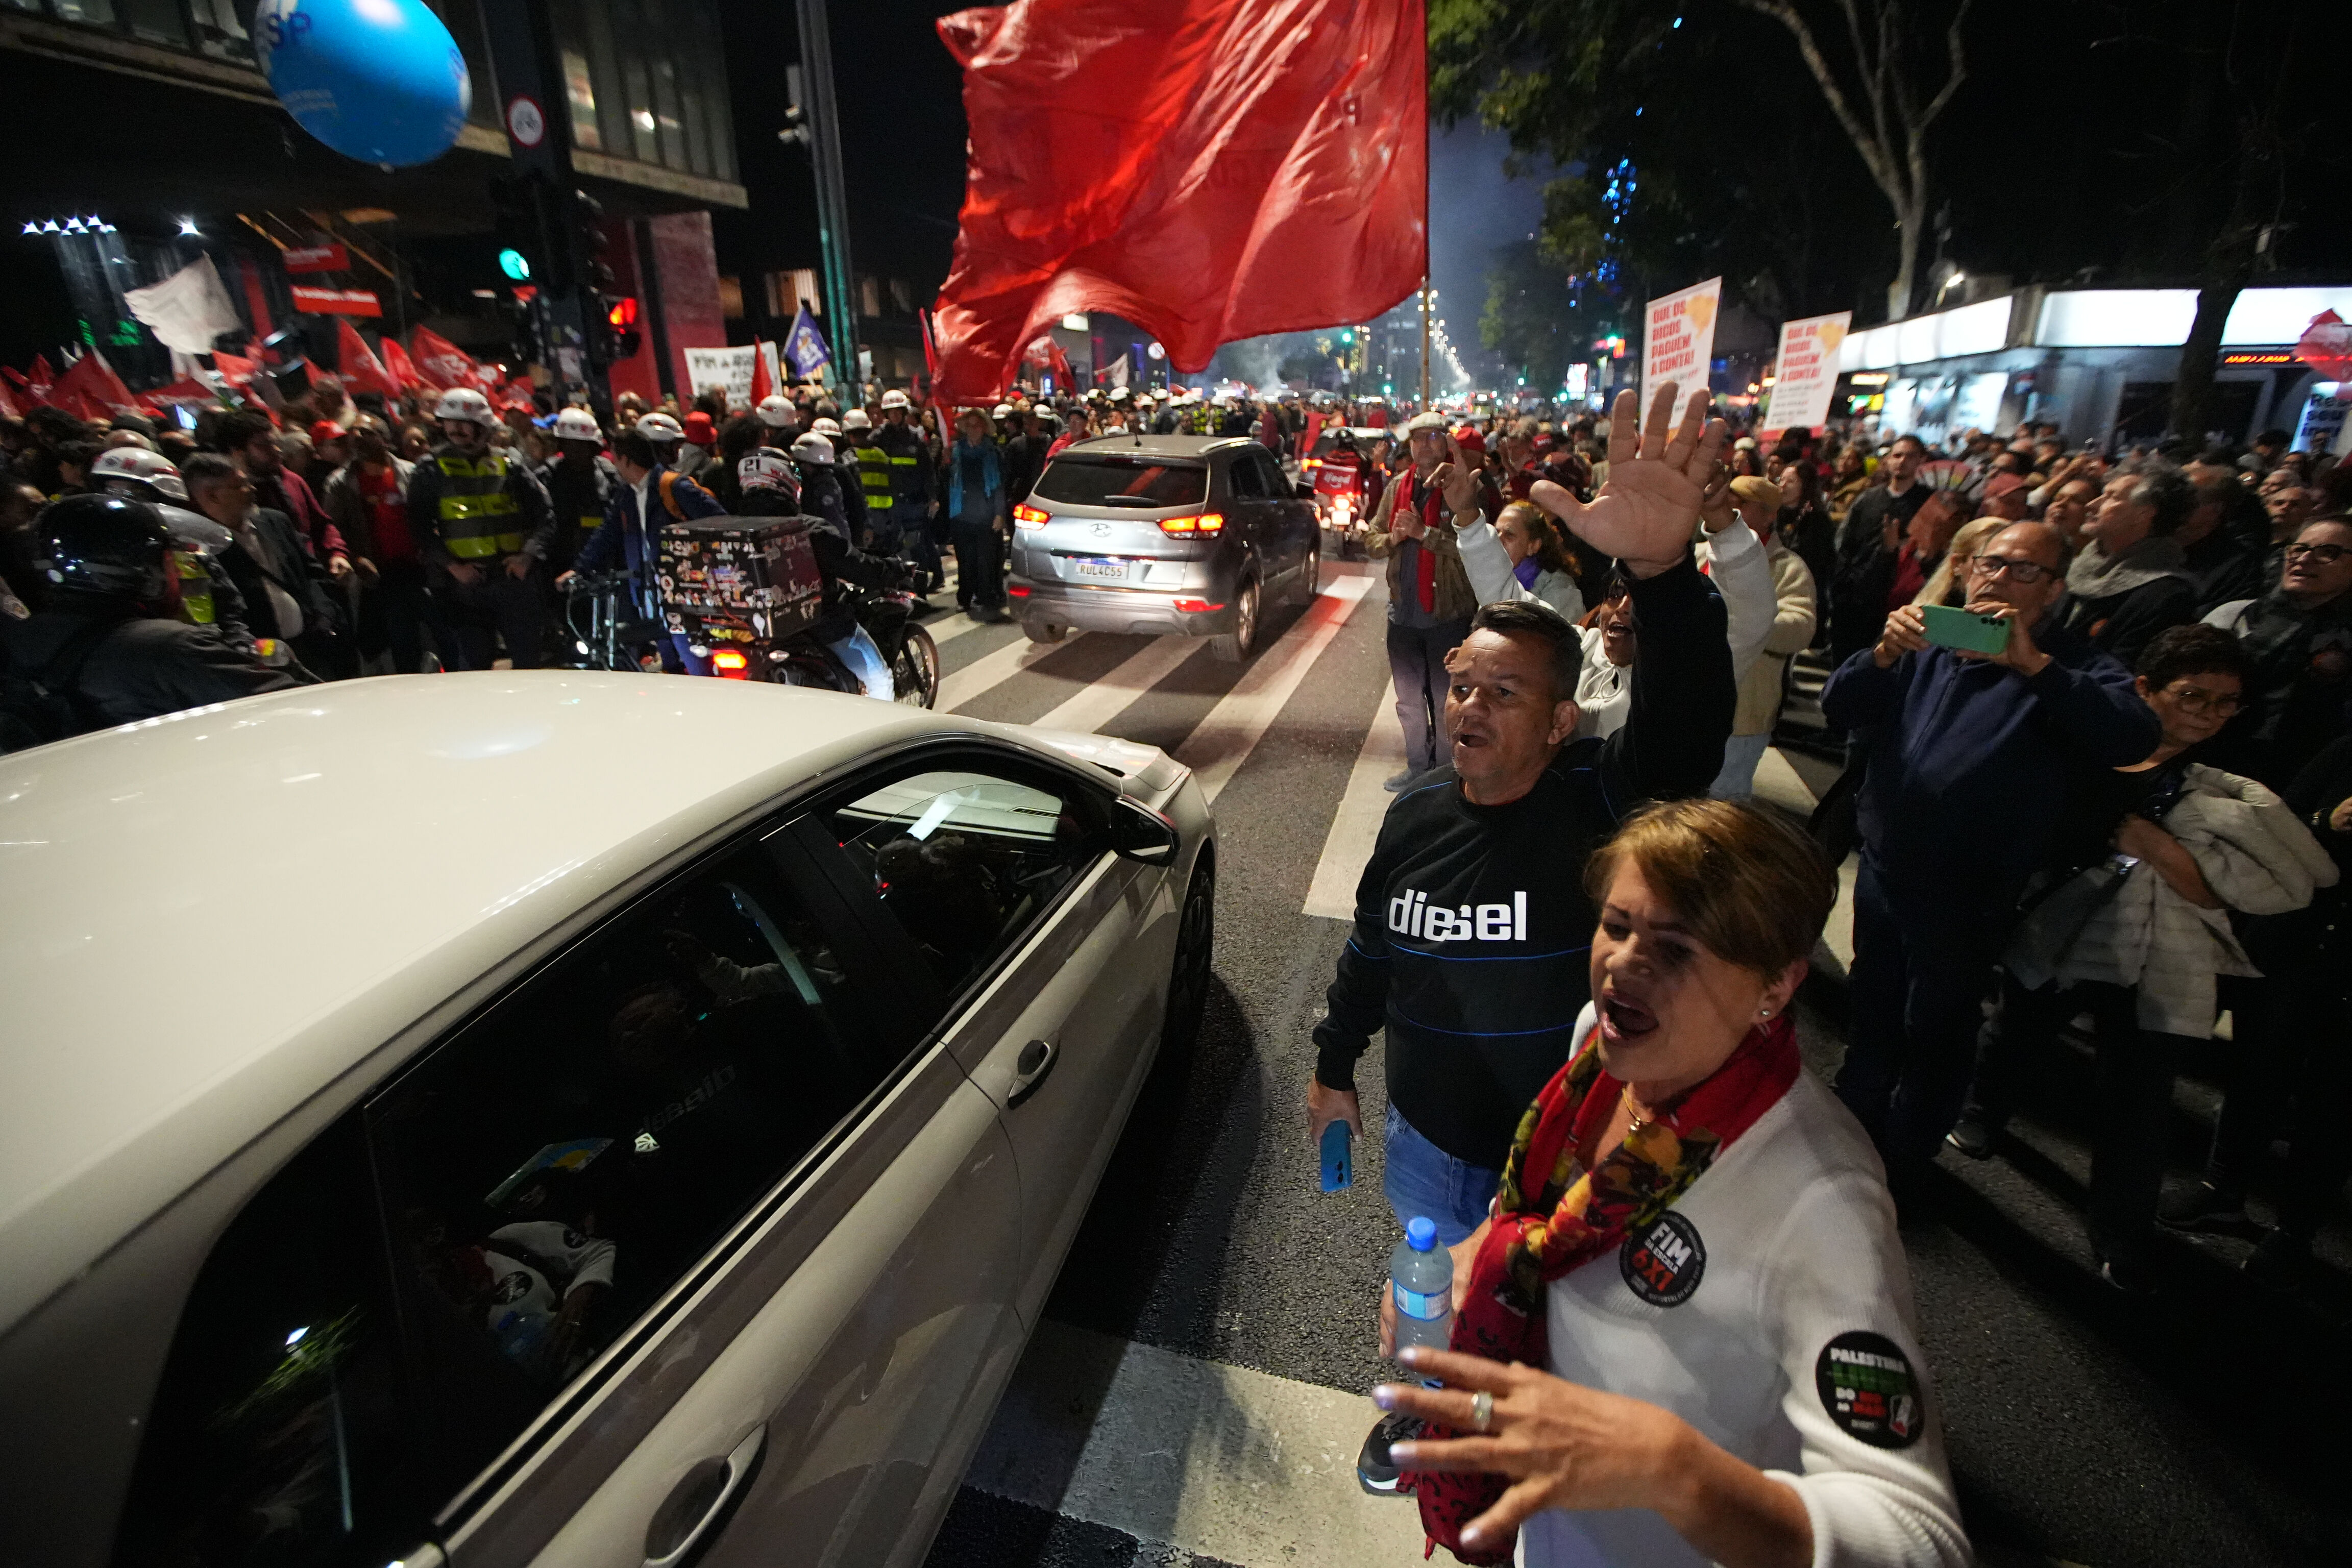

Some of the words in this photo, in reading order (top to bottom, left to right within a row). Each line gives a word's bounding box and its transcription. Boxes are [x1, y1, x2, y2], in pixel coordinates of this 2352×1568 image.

[1653, 319, 1681, 342] RICOS
[1651, 333, 1692, 359] PAGUEM
[1651, 362, 1657, 376] A
[1659, 349, 1695, 373] CONTA!
[1081, 565, 1122, 577] RUL4C55
[1389, 889, 1527, 942] diesel
[1650, 1221, 1693, 1268] FIM
